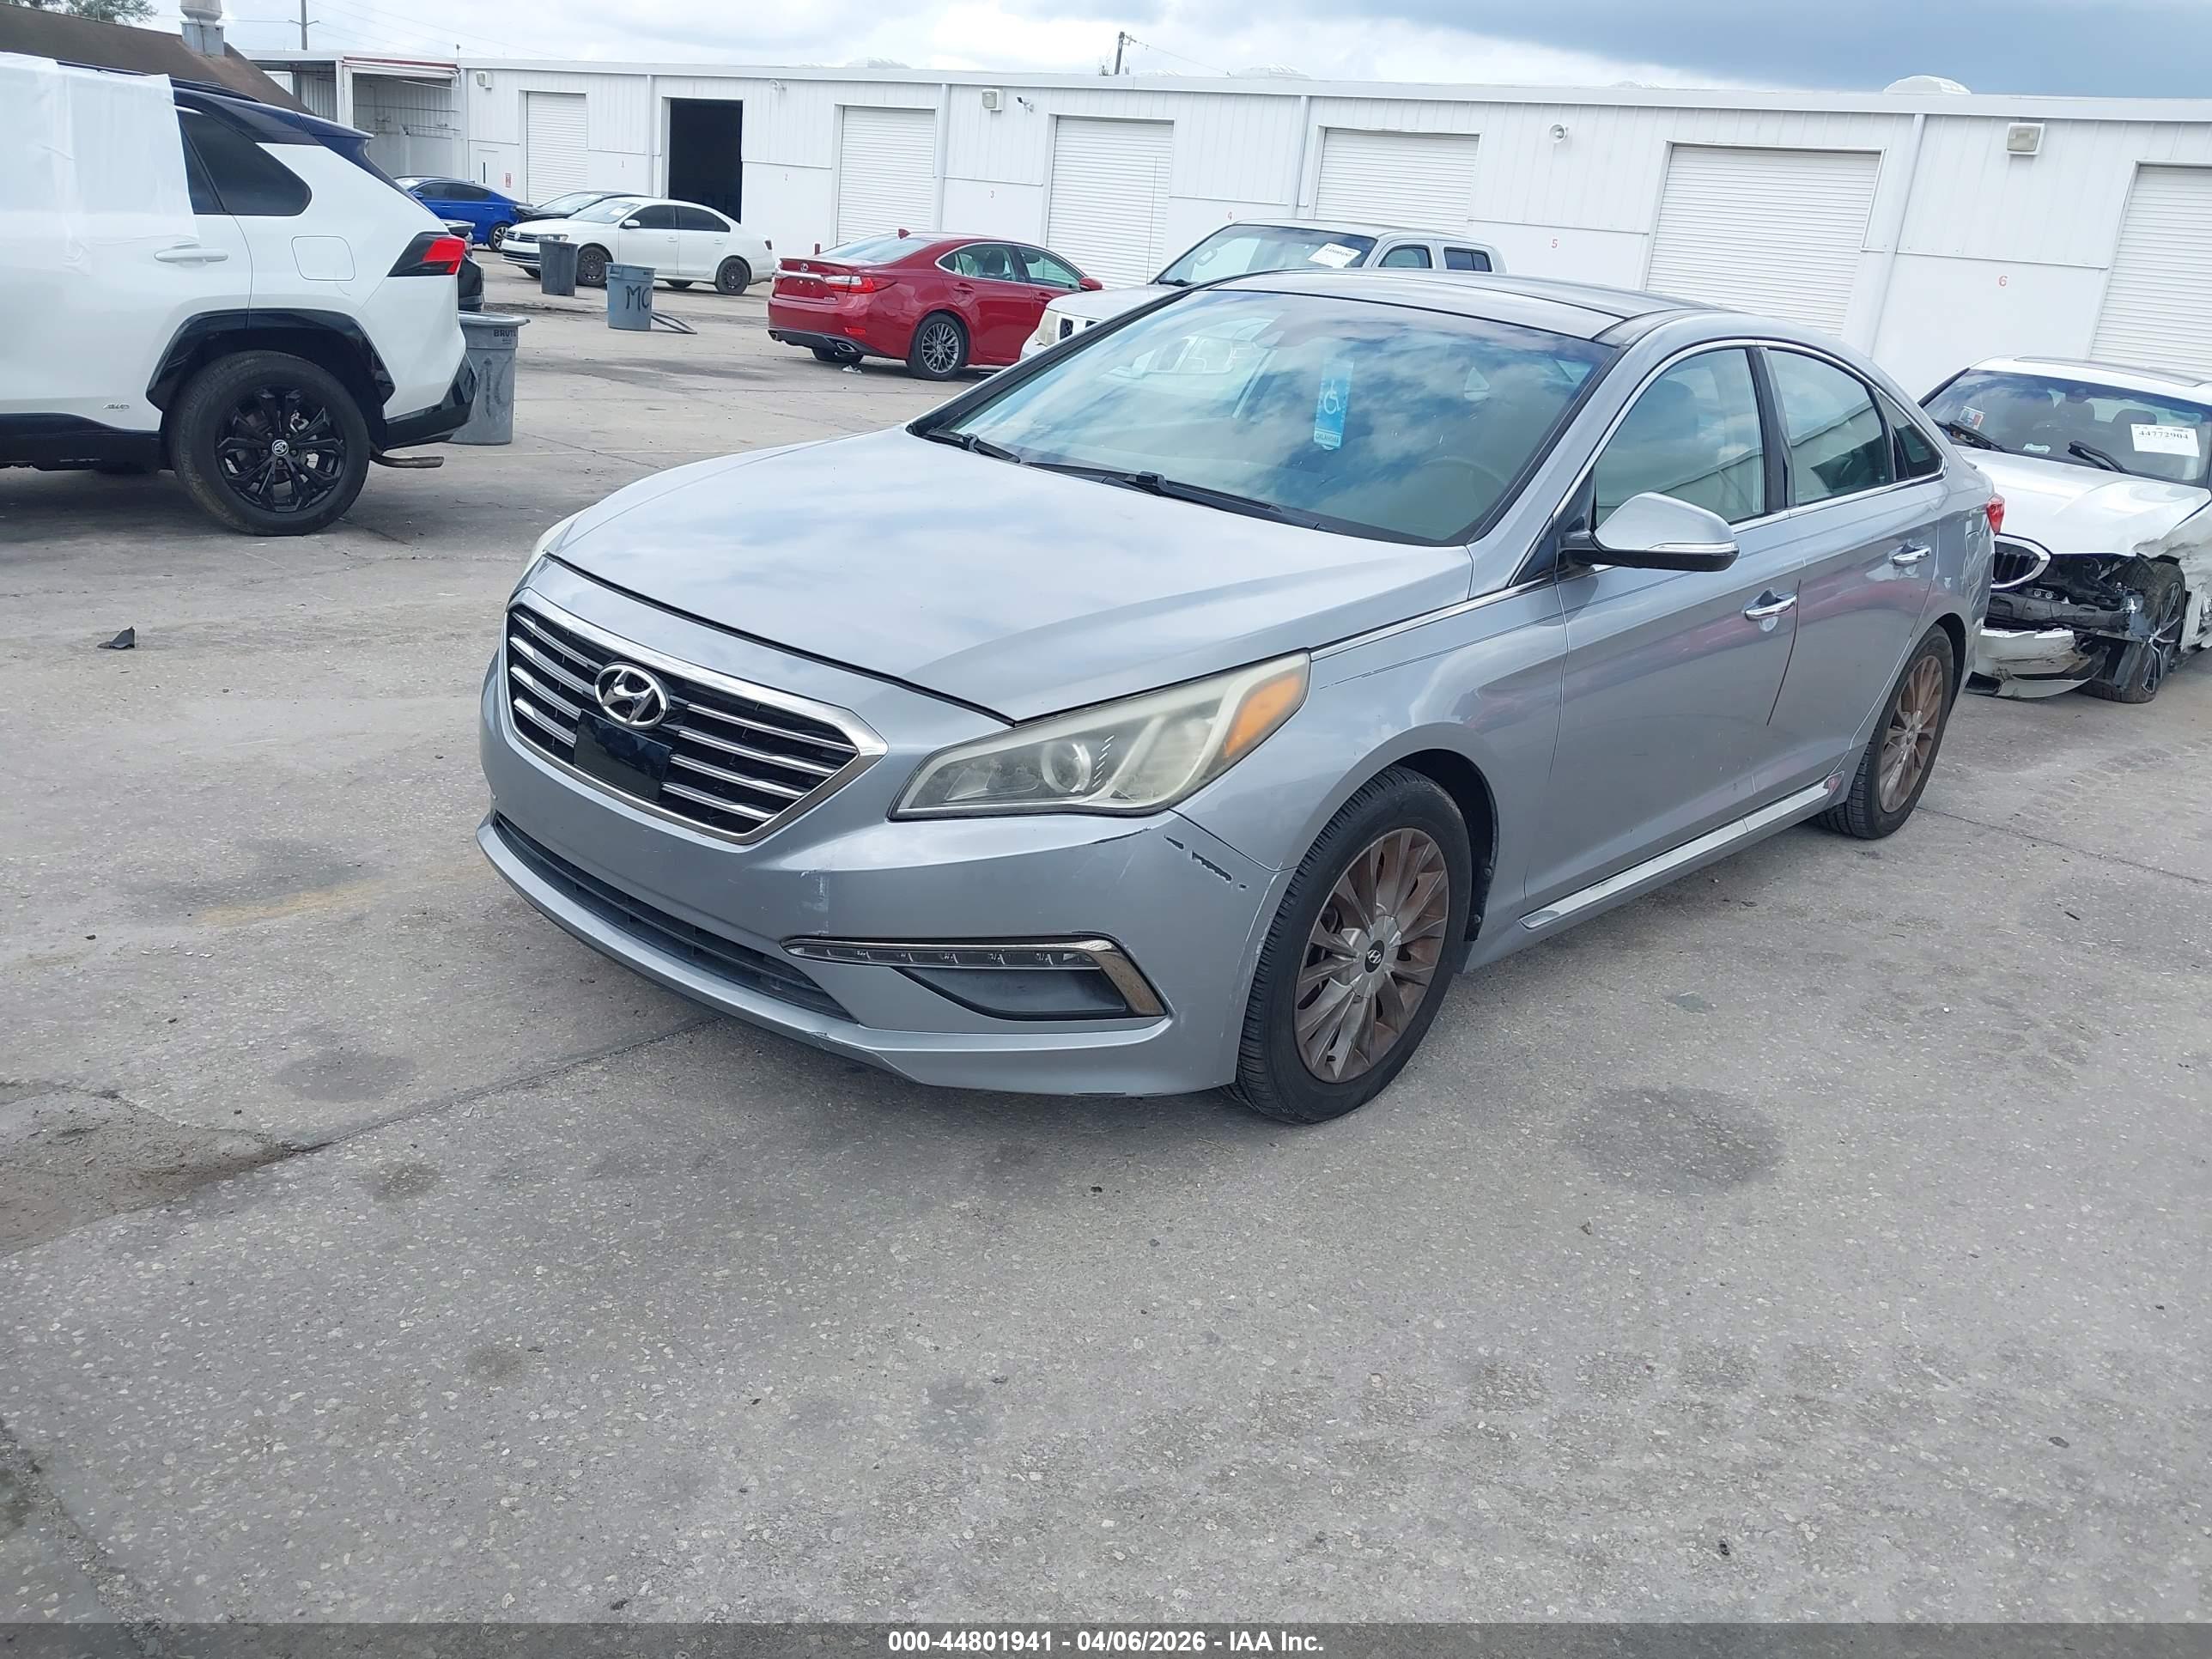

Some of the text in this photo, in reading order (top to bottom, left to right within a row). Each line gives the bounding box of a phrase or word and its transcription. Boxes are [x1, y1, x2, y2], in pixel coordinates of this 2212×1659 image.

[1551, 239, 1559, 249] 5
[1998, 275, 2008, 287] 6
[626, 285, 650, 312] MC
